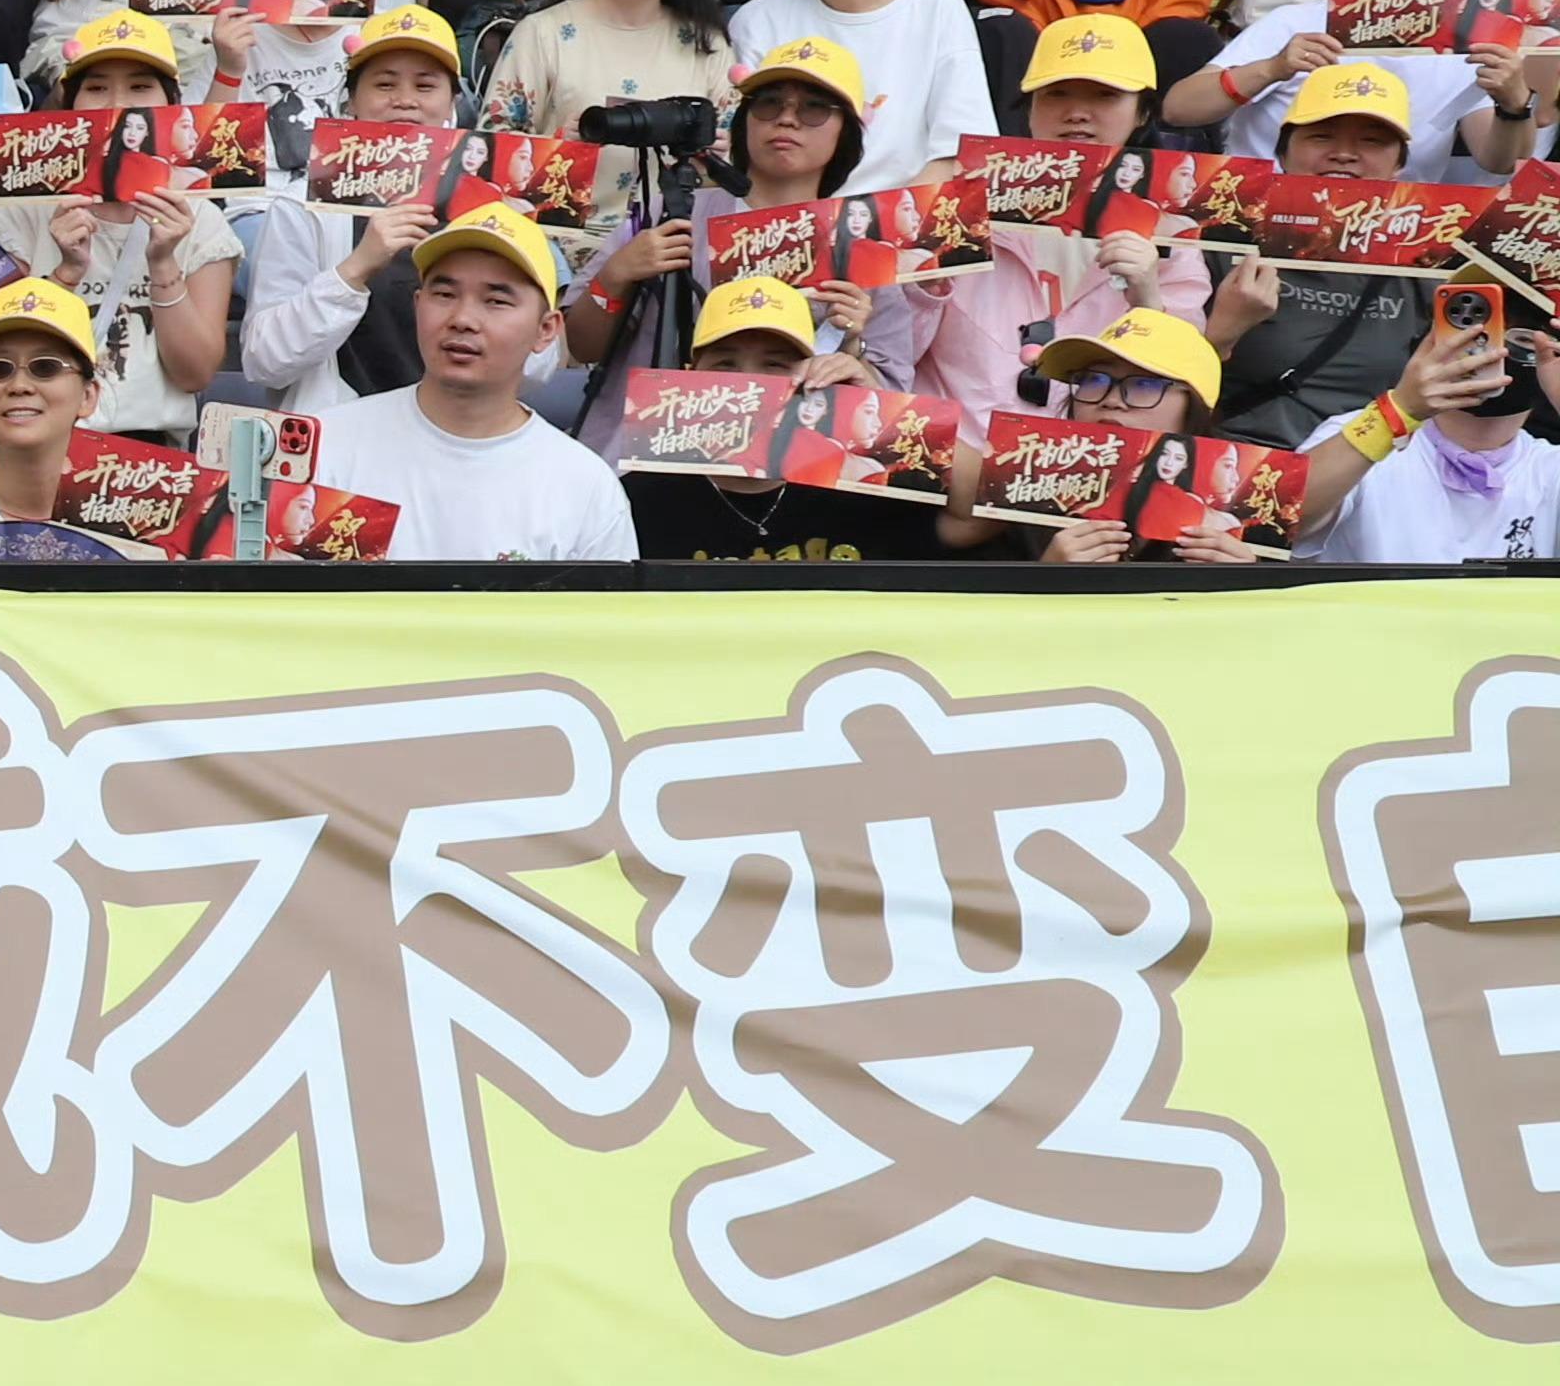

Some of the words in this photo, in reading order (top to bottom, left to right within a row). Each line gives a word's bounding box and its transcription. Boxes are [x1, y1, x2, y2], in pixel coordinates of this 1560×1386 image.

[324, 131, 432, 168] 开机大吉
[966, 149, 1086, 181] 开机大吉
[721, 212, 816, 262] 开机大吉
[1333, 199, 1470, 256] 陈丽君
[1301, 303, 1388, 320] EXPEDIION
[639, 383, 765, 429] 开机大吉
[74, 455, 199, 496] 开机大吉
[997, 434, 1126, 476] 开机大吉
